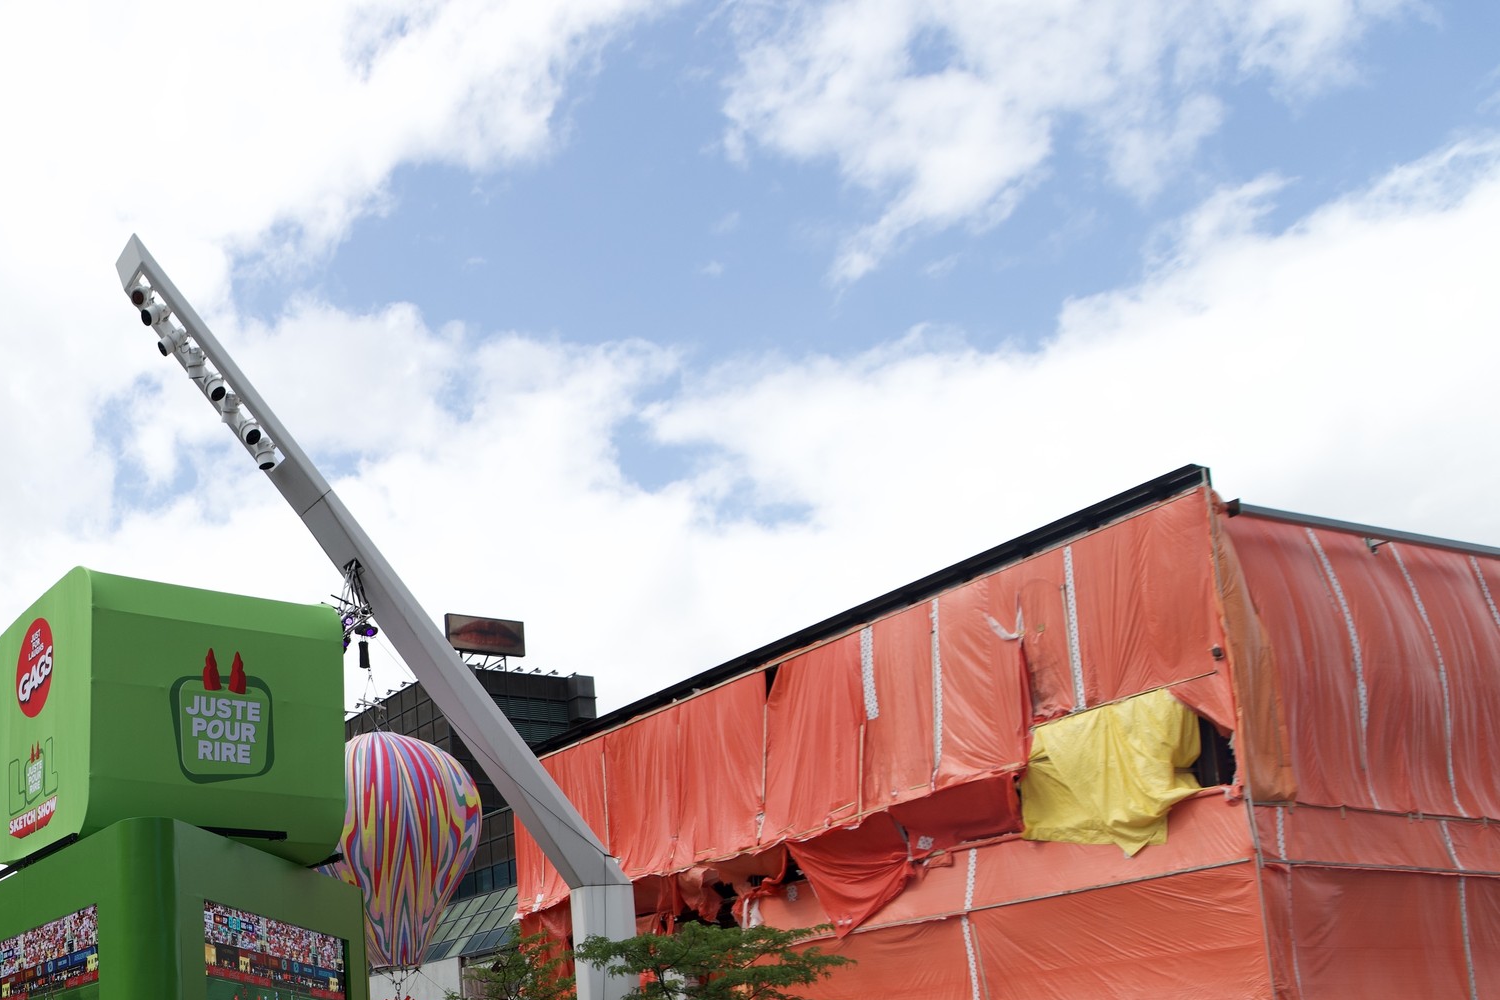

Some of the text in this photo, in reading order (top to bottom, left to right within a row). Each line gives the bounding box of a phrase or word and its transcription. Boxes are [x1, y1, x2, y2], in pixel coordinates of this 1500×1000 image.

[18, 645, 52, 702] GAGS
[185, 695, 261, 722] JUSTE
[192, 717, 256, 743] POUR
[198, 739, 251, 764] RIRE
[28, 760, 43, 777] JUSTE
[28, 769, 41, 786] POUR
[29, 781, 40, 794] RIRE
[9, 795, 57, 834] SKETCH SHOW
